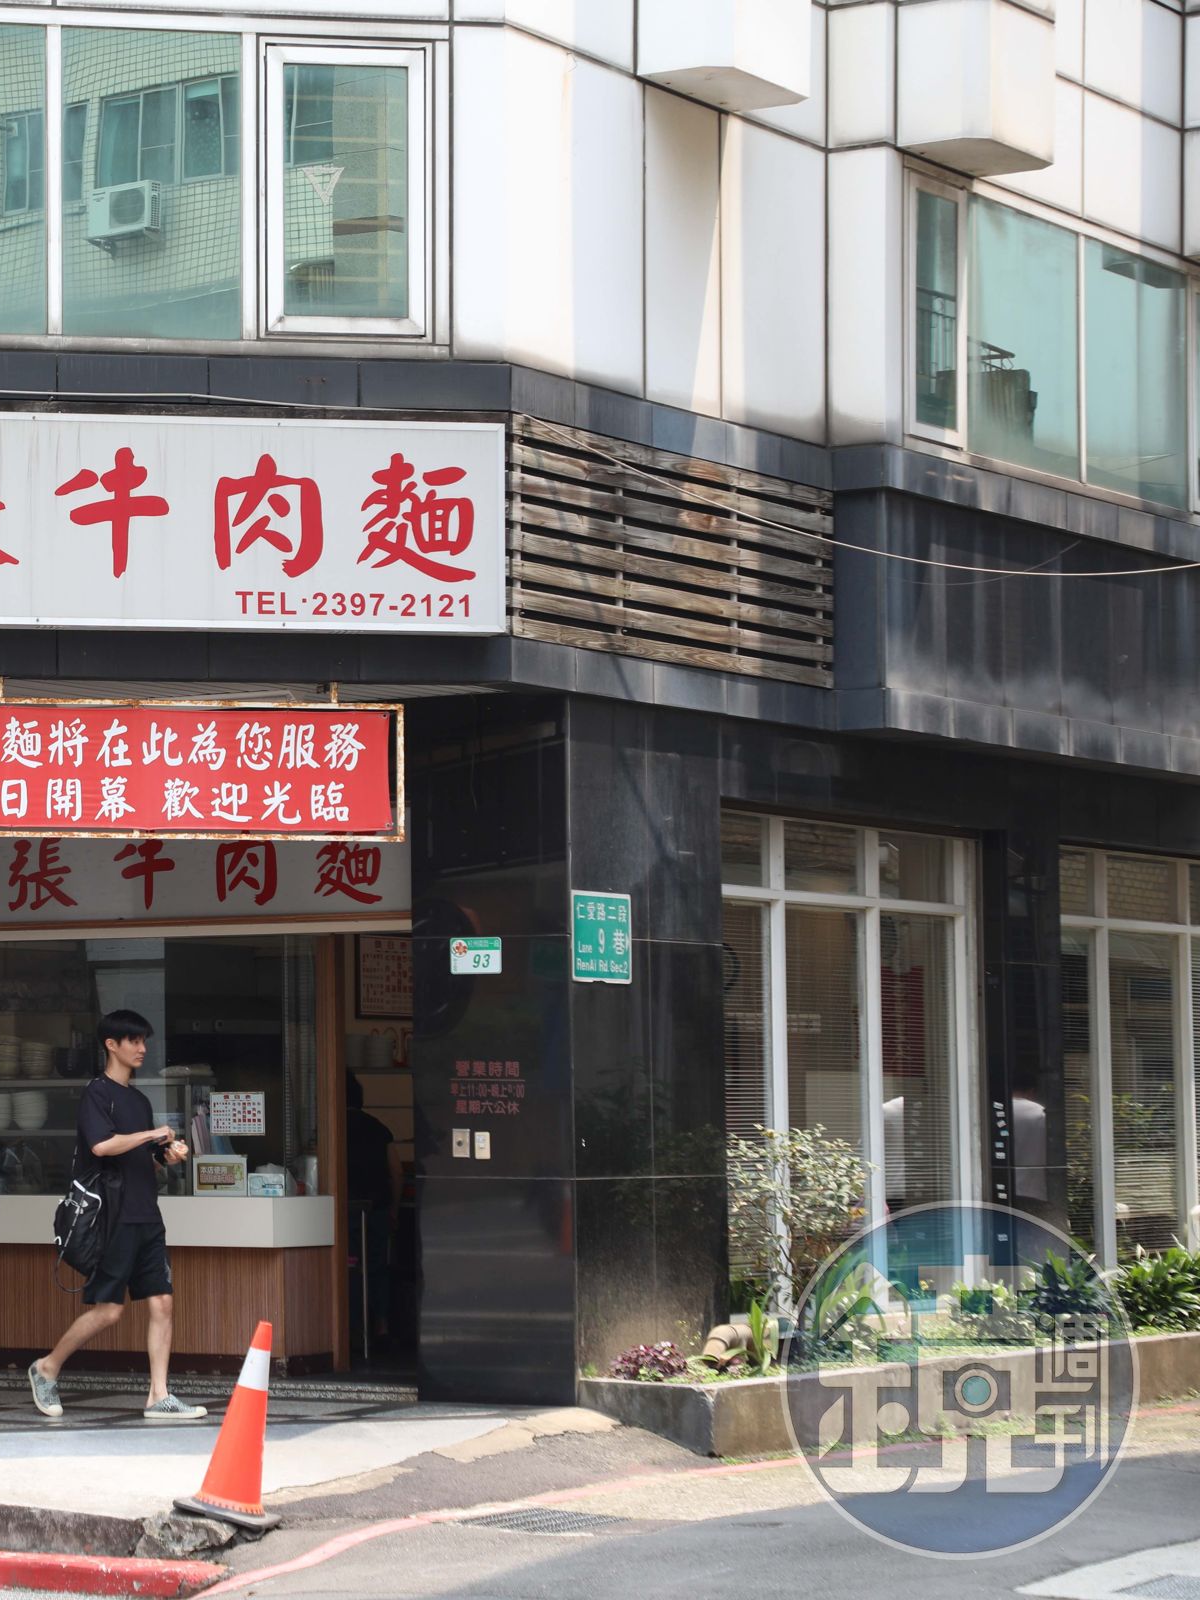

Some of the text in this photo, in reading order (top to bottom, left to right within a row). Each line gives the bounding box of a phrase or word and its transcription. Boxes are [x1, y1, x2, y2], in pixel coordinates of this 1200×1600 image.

[576, 901, 627, 923] 仁愛路二段
[578, 940, 593, 953] Lane
[598, 927, 605, 954] 9
[472, 953, 491, 969] 93
[455, 1060, 520, 1077] 營業時間
[455, 1100, 520, 1115] 星期六公休
